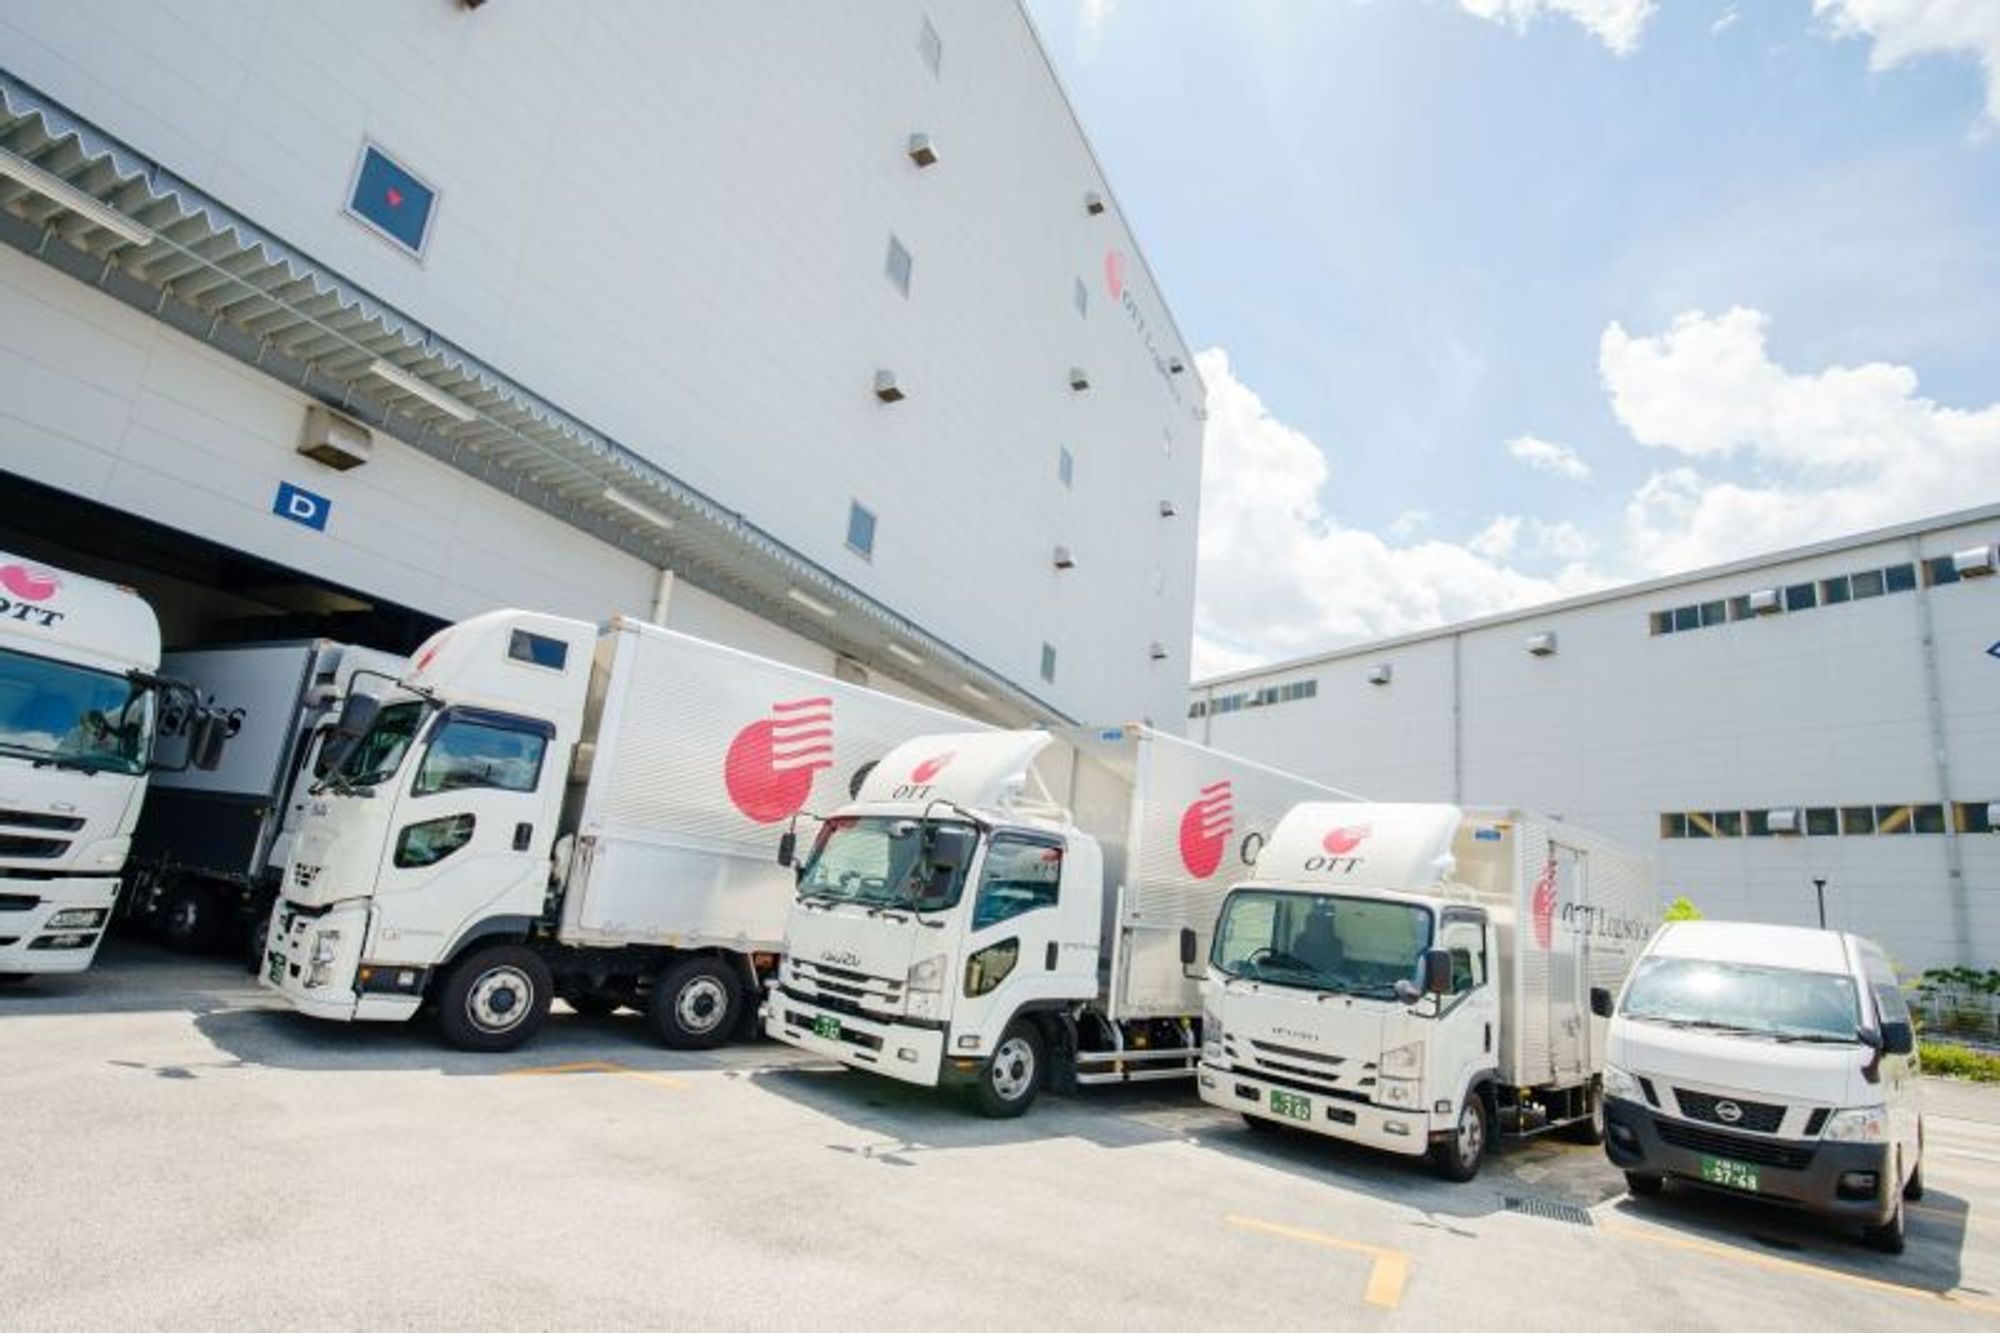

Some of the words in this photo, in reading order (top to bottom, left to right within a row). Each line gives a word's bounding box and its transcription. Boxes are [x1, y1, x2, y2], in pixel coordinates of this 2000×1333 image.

[290, 494, 316, 518] D
[892, 784, 936, 800] OTT
[1304, 857, 1365, 874] OTT
